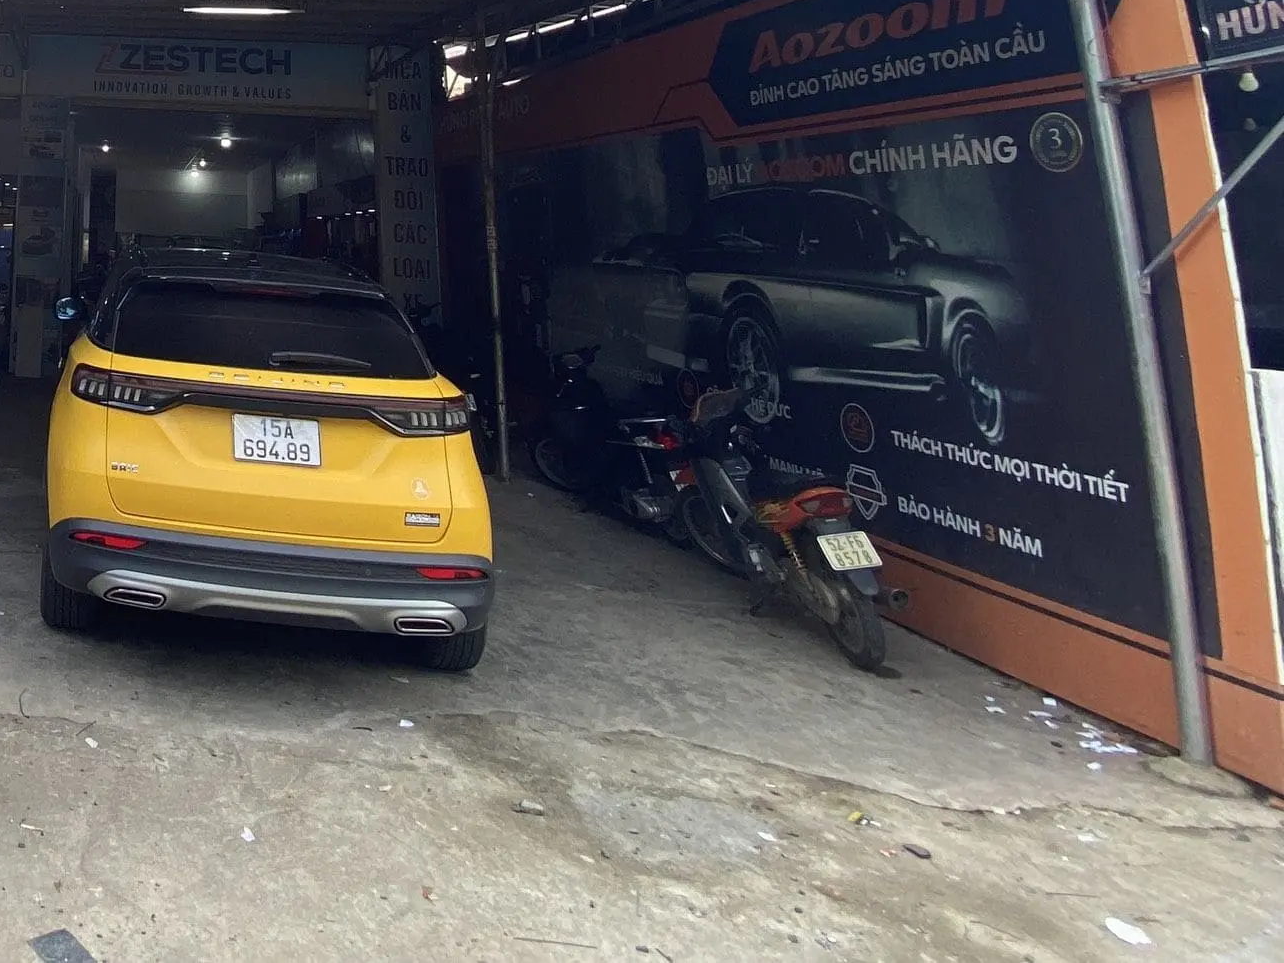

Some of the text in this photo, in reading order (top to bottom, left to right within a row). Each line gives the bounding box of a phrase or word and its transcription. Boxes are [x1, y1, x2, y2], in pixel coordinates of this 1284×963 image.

[118, 43, 292, 76] ZESTECH
[786, 79, 820, 100] CAO
[821, 68, 870, 94] TĂNG
[872, 55, 926, 84] SÁNG
[928, 38, 991, 73] TOÀN
[994, 21, 1047, 59] CẦU
[177, 83, 228, 98] GROWTH
[232, 85, 240, 99] &
[245, 85, 292, 100] VALUES
[1048, 127, 1063, 150] 3
[385, 156, 429, 178] TRAO
[848, 139, 925, 176] CHÍNH
[931, 134, 1018, 170] HÃNG
[259, 417, 295, 439] 15A
[242, 438, 311, 462] 694.89
[890, 430, 1130, 503] THÁCH THỨC MỌI THỜI TIẾT
[933, 507, 982, 538] HÀNH
[983, 522, 998, 542] 3
[998, 525, 1043, 558] NĂM
[834, 548, 873, 567] 8578
